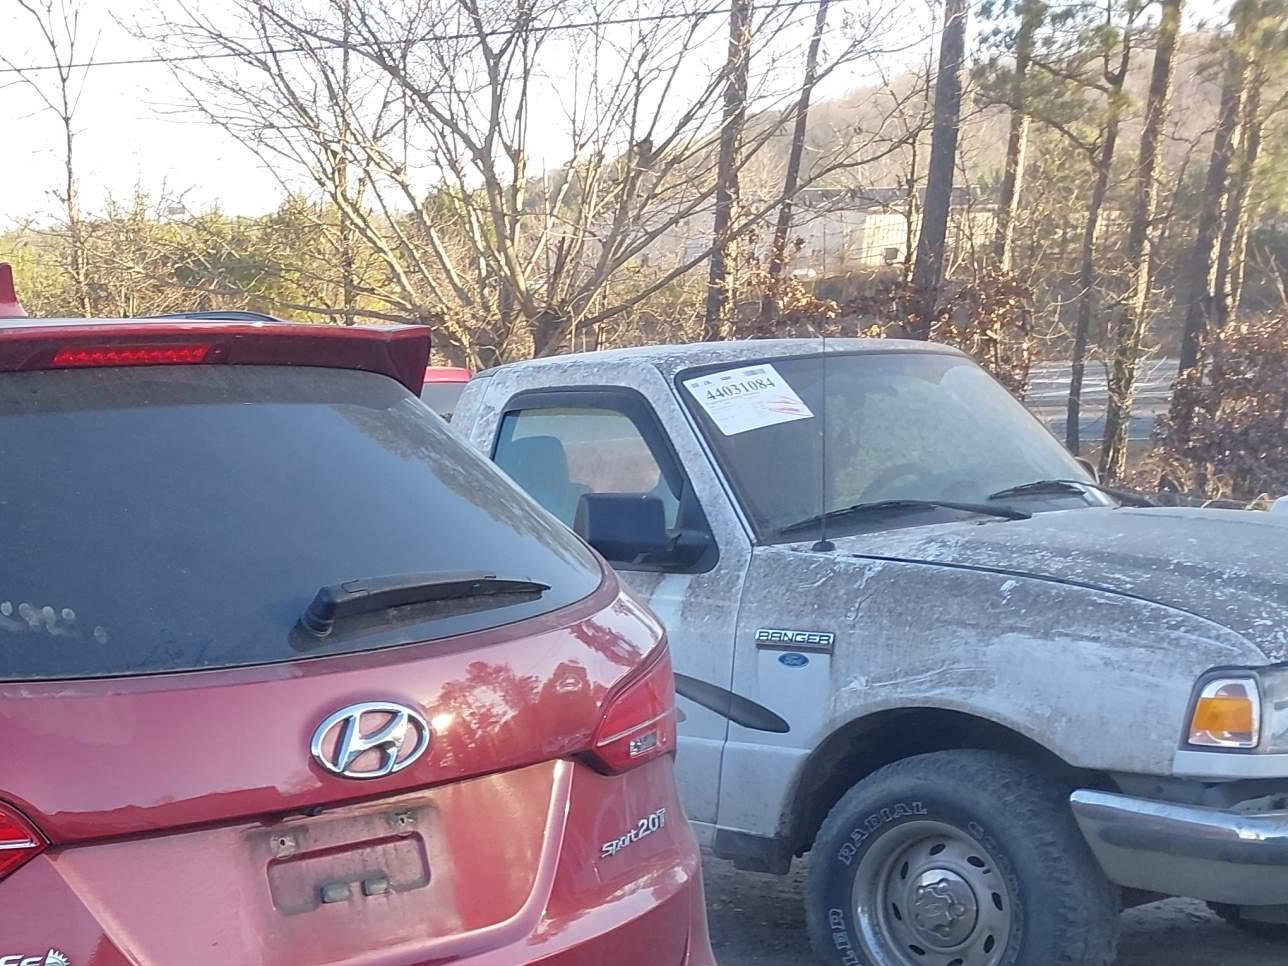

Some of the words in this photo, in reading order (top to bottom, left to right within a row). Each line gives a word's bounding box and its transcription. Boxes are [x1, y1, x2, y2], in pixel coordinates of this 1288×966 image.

[706, 377, 776, 400] 44031084
[755, 629, 832, 645] RANGER
[838, 801, 928, 865] RADIAL
